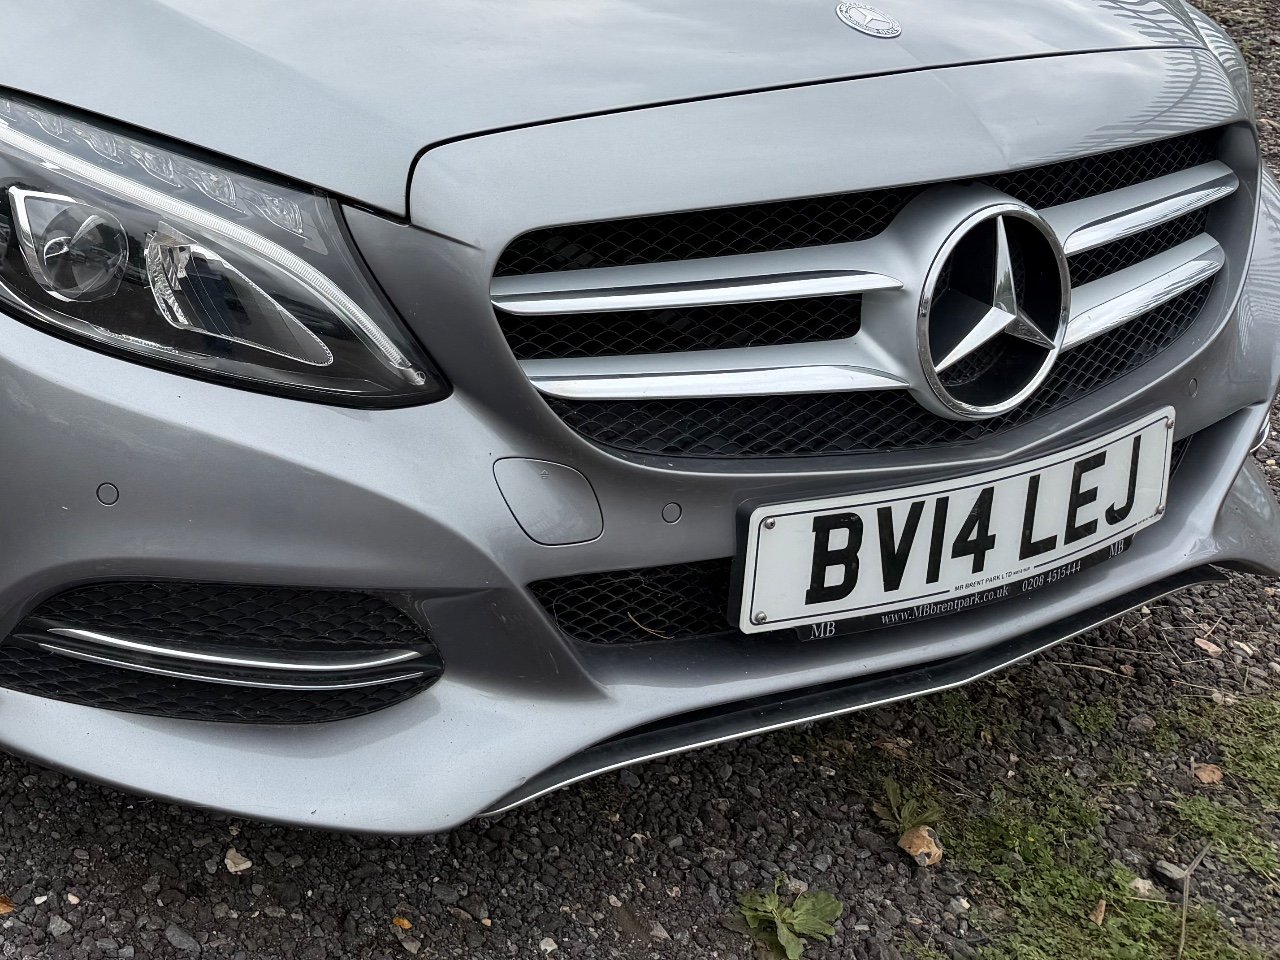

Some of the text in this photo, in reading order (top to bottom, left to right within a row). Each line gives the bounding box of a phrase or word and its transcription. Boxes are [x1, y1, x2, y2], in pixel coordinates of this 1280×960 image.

[805, 434, 1142, 605] BV14 LEJ
[1108, 539, 1125, 558] MB
[985, 574, 1001, 585] PARK
[1001, 571, 1013, 580] LTD
[1021, 577, 1045, 592] 0208
[1046, 560, 1081, 584] 4515444
[881, 585, 1010, 625] www.MBbrentpark.co.uk
[810, 621, 836, 639] MB
